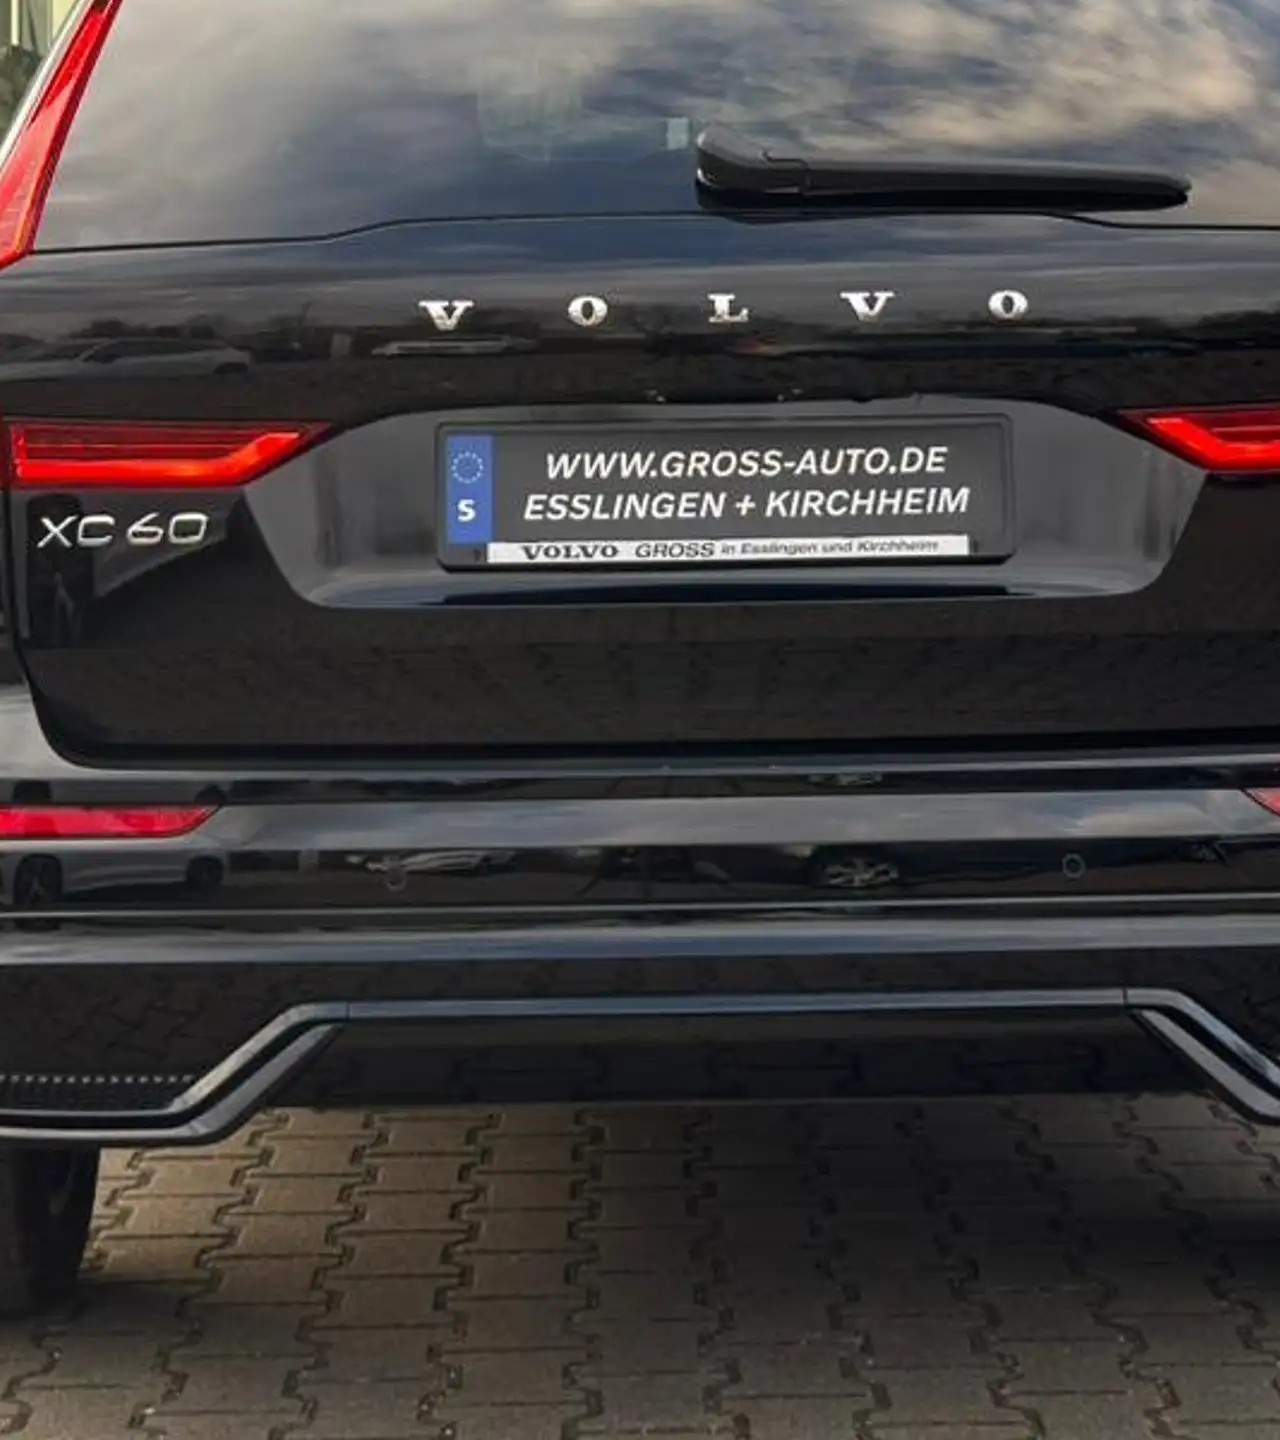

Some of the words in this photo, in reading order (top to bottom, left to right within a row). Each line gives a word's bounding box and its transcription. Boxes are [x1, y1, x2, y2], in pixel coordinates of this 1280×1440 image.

[419, 289, 1030, 331] VOLVO
[545, 446, 949, 481] WWW.GROSS-AUTO.DE
[457, 498, 477, 522] S
[523, 491, 726, 521] ESSLINGEN
[765, 487, 970, 518] KIRCHHEIM
[521, 544, 619, 561] VOLVO
[635, 542, 715, 559] GROSS
[822, 540, 852, 553] und
